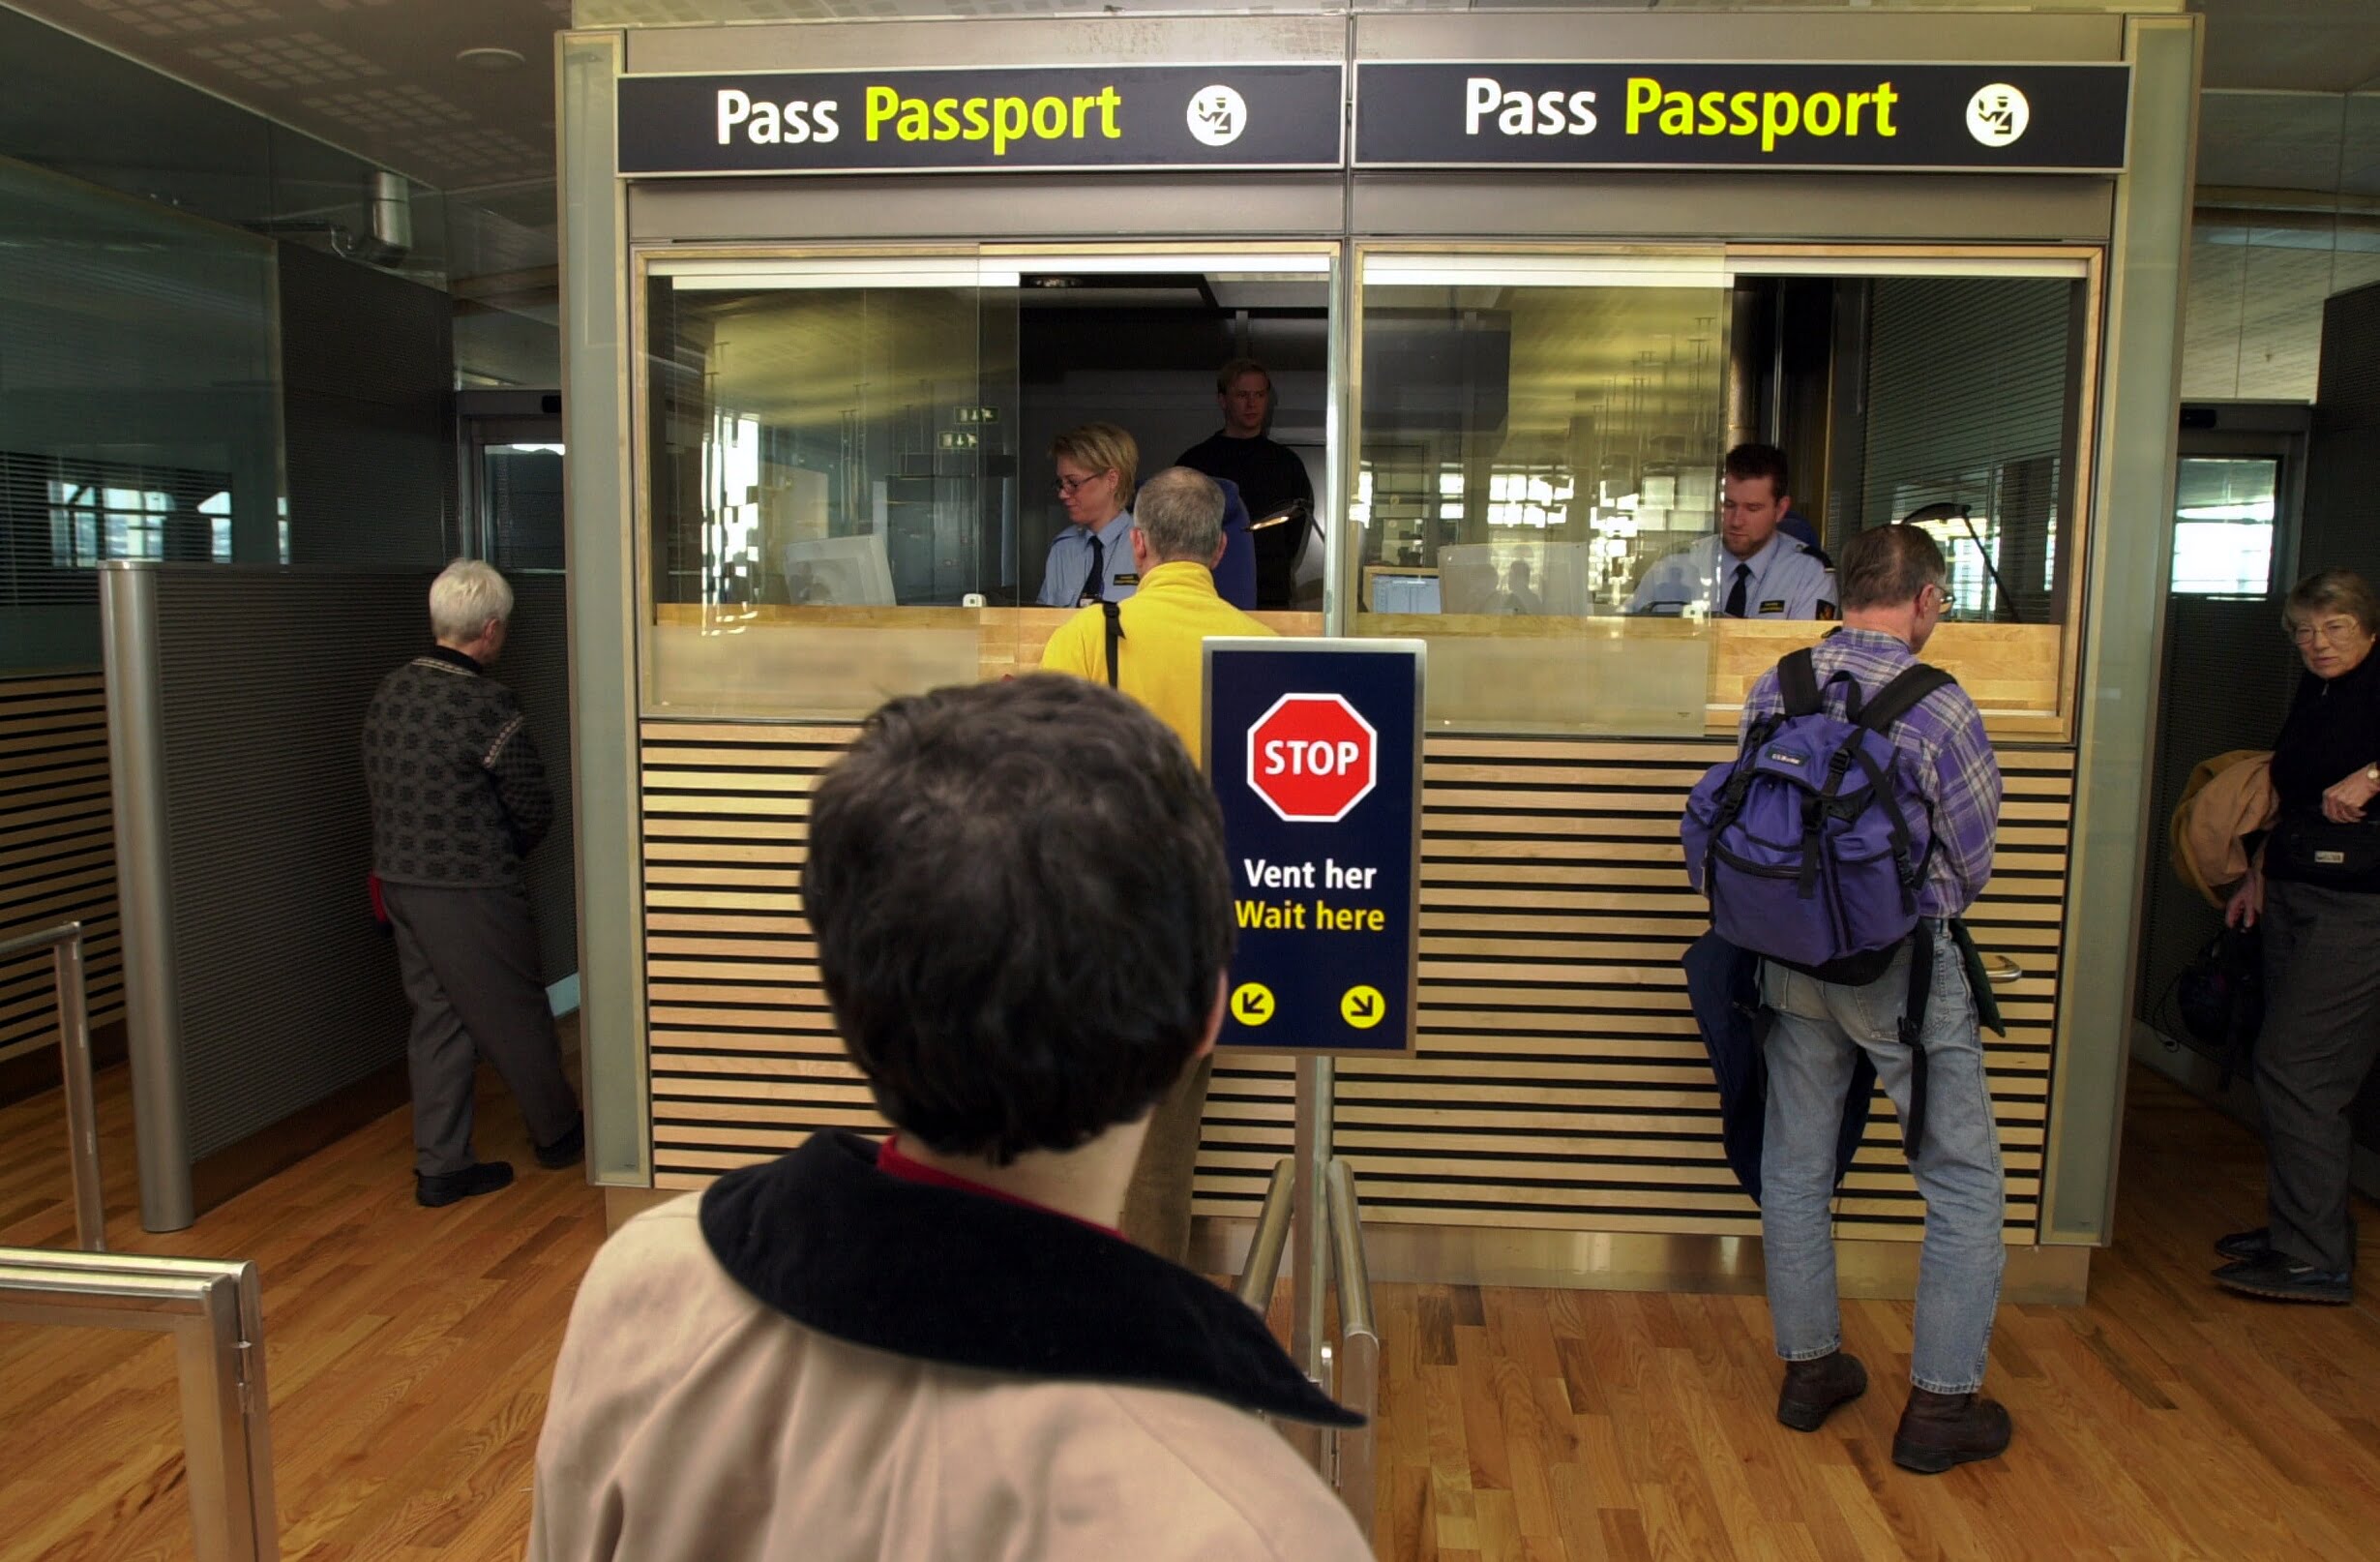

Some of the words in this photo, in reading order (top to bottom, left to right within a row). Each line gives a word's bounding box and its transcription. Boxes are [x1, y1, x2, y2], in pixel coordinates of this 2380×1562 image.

[717, 89, 839, 144] Pass
[866, 85, 1121, 155] Passport
[1466, 77, 1597, 135] Pass
[1626, 78, 1898, 152] Passport
[1264, 740, 1359, 775] STOP
[1244, 858, 1316, 888] Vent
[1325, 858, 1378, 889] her
[1235, 900, 1306, 930] Wait
[1317, 900, 1385, 930] here
